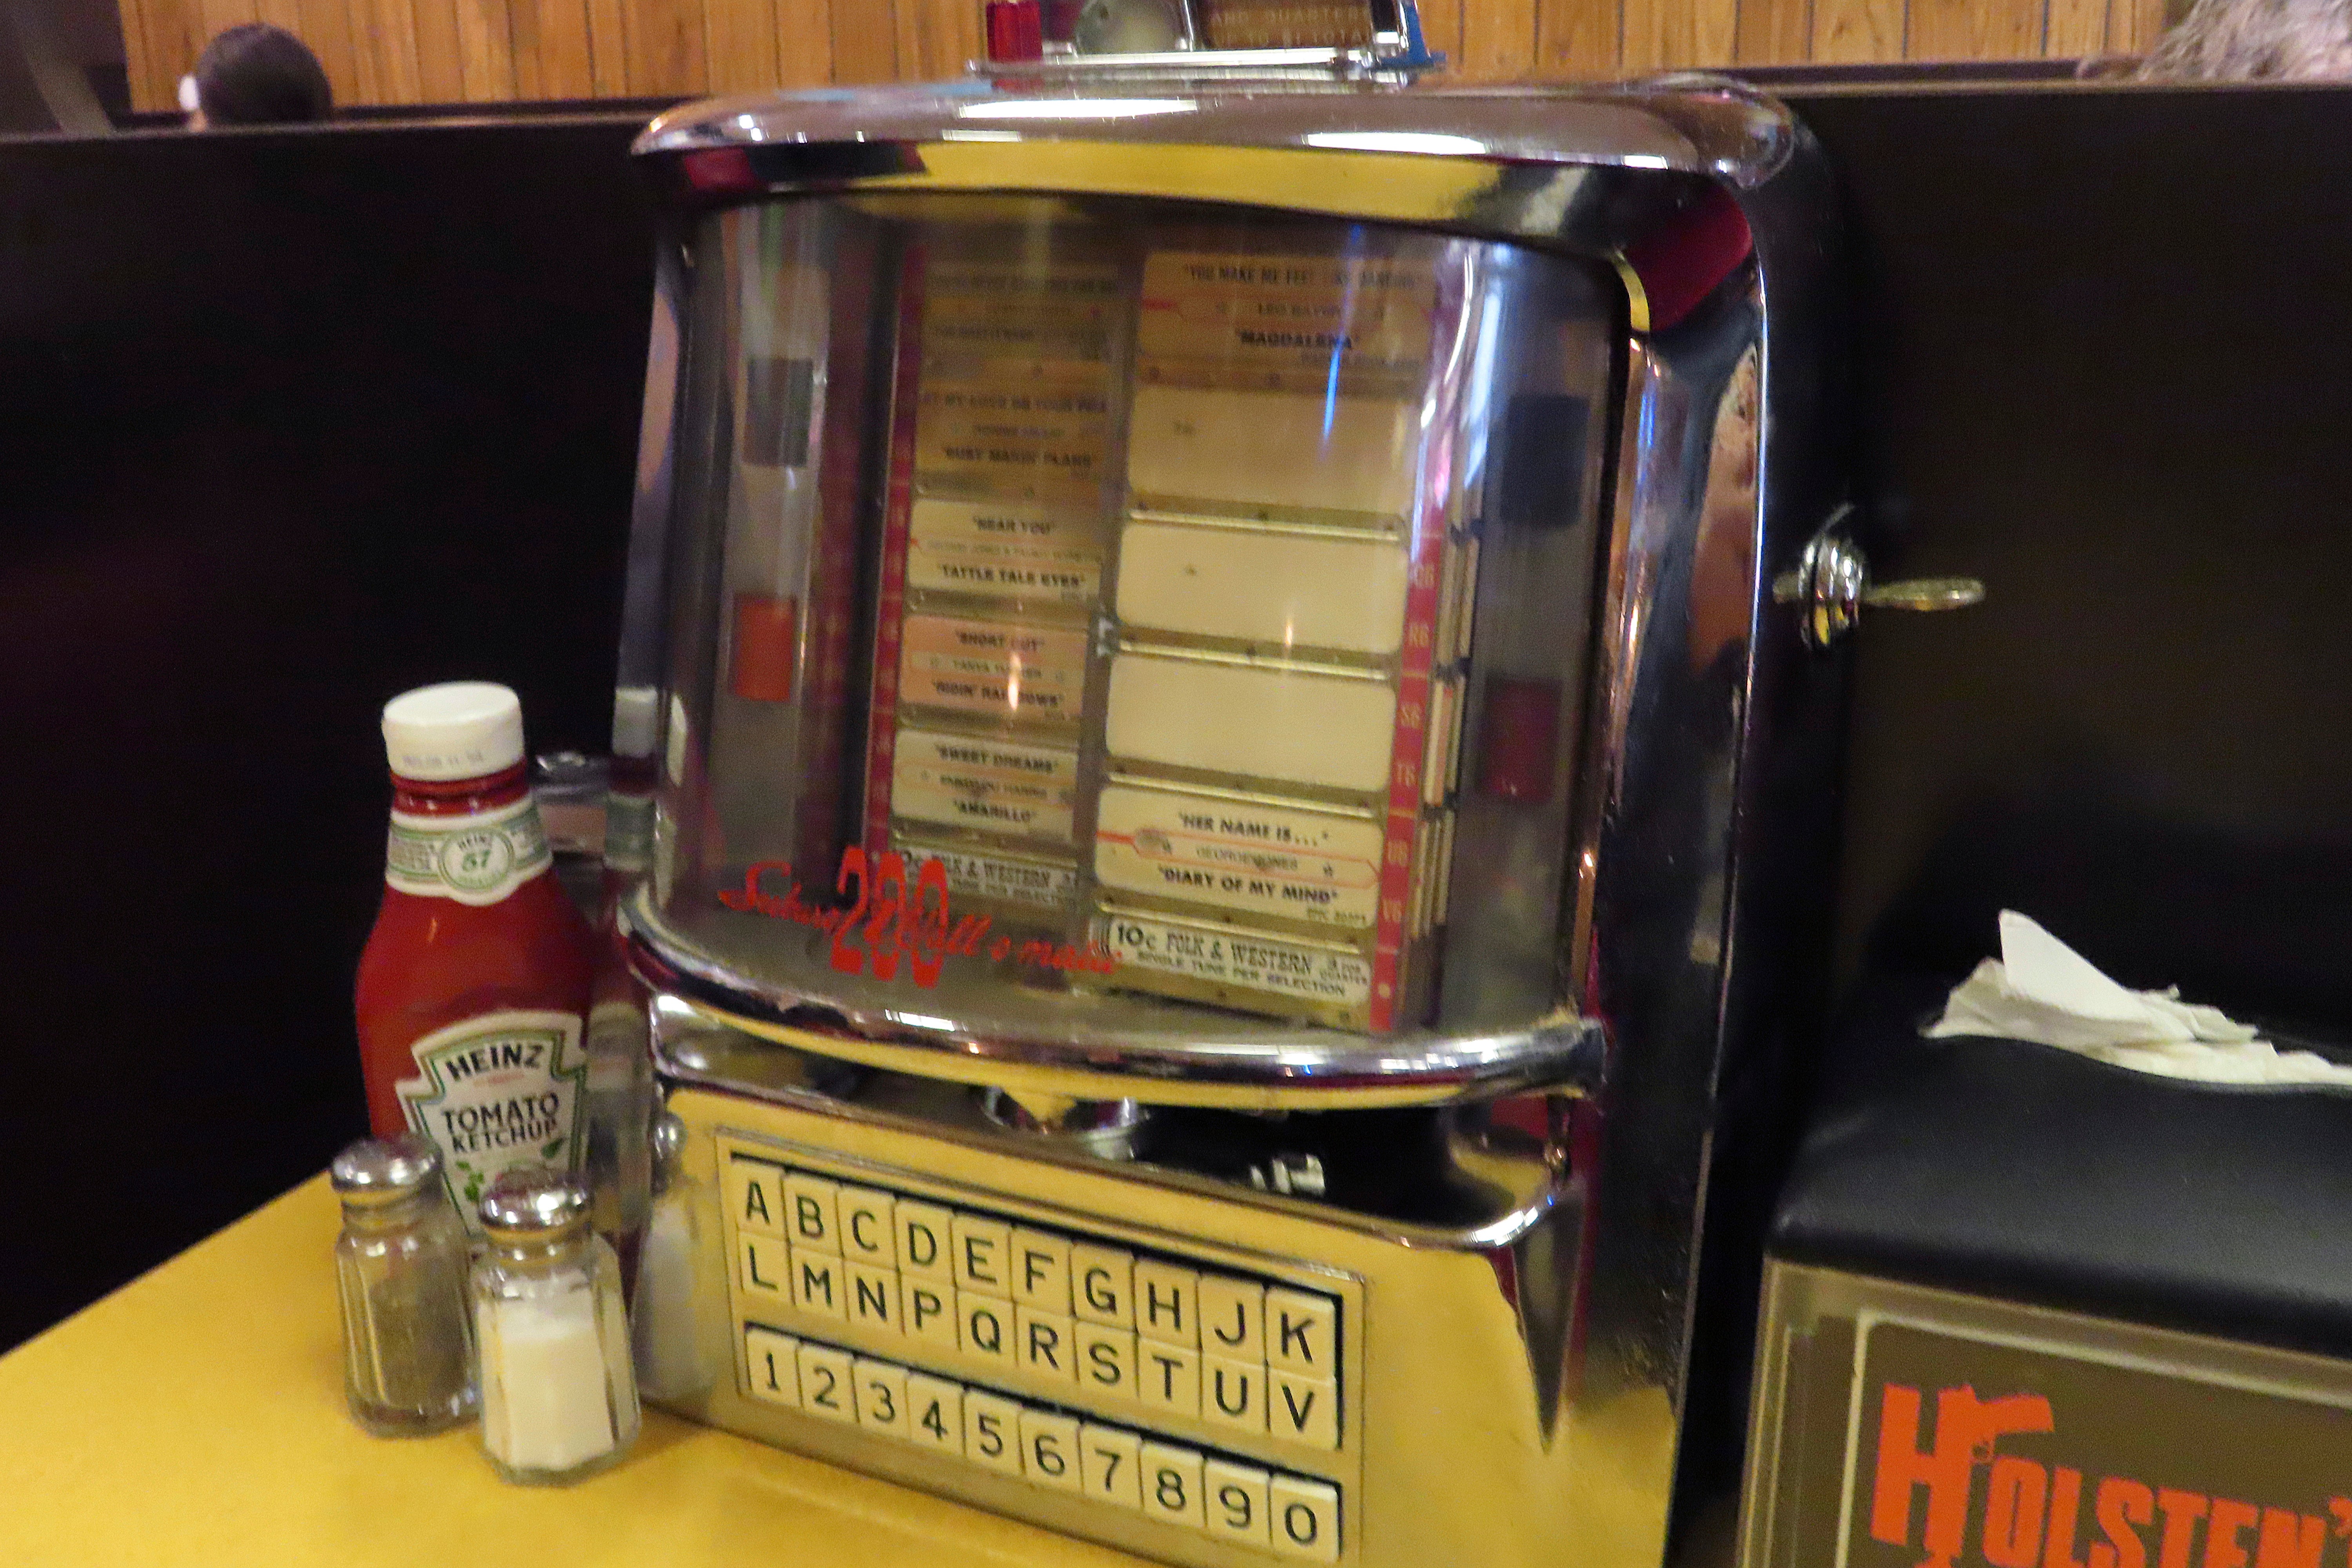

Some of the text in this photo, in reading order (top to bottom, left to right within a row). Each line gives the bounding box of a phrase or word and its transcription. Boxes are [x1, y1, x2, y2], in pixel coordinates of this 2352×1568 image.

[1220, 817, 1270, 840] NAME
[1221, 873, 1243, 893] OF
[1249, 878, 1276, 900] MY
[1167, 931, 1204, 958] FOLK
[1210, 940, 1222, 961] &
[1230, 942, 1313, 976] WESTERN
[446, 1043, 544, 1082] HEINZ
[441, 1092, 560, 1135] TOMATO
[450, 1118, 558, 1153] KETCHUP
[745, 1180, 1314, 1363] A B C D E F G H J K
[748, 1245, 1316, 1432] L M N P Q R S T U V
[765, 1351, 781, 1390] 1
[813, 1366, 839, 1409] 2
[870, 1383, 897, 1423] 3
[921, 1399, 948, 1440] 4
[977, 1413, 1004, 1458] 5
[1033, 1434, 1066, 1476] 6
[1096, 1448, 1123, 1491] 7
[1155, 1468, 1187, 1512] 8
[1220, 1486, 1252, 1529] 9
[1869, 1384, 2352, 1568] HOLSTEN'
